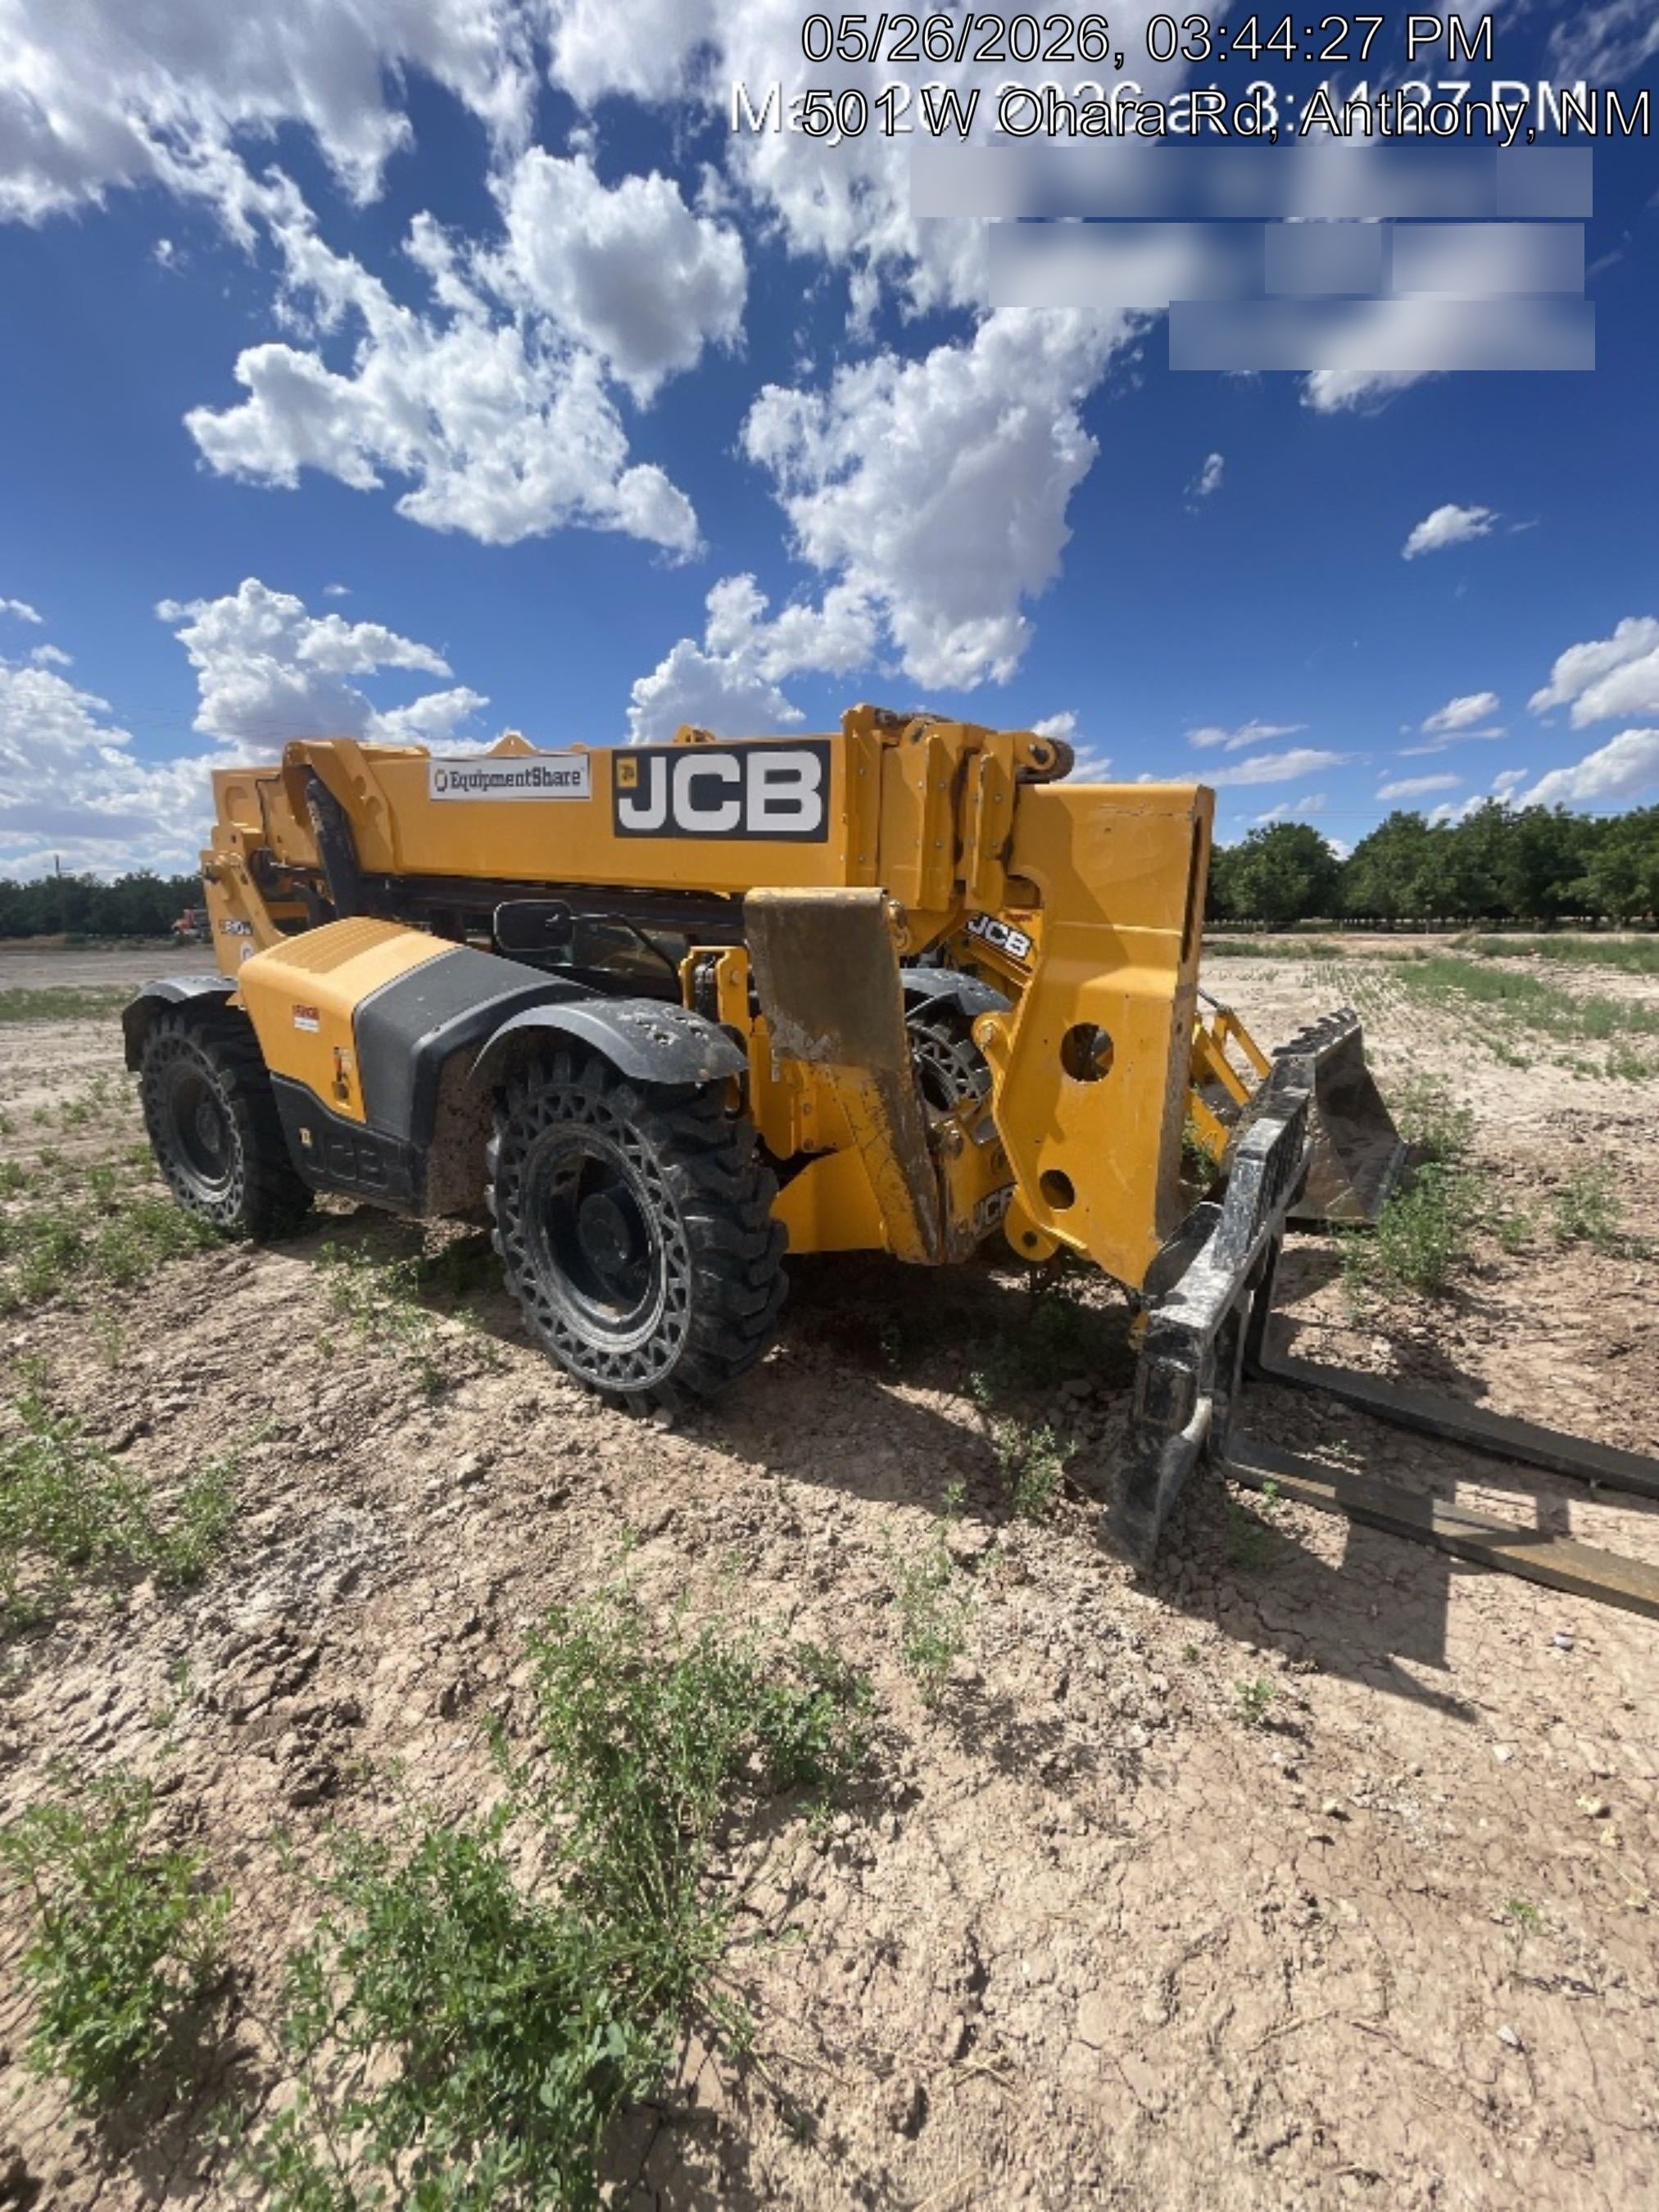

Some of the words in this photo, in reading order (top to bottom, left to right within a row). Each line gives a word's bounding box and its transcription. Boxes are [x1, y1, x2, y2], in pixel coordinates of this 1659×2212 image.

[450, 766, 582, 792] EquipmentShare
[618, 750, 823, 832] JCB
[968, 915, 1031, 957] JCB
